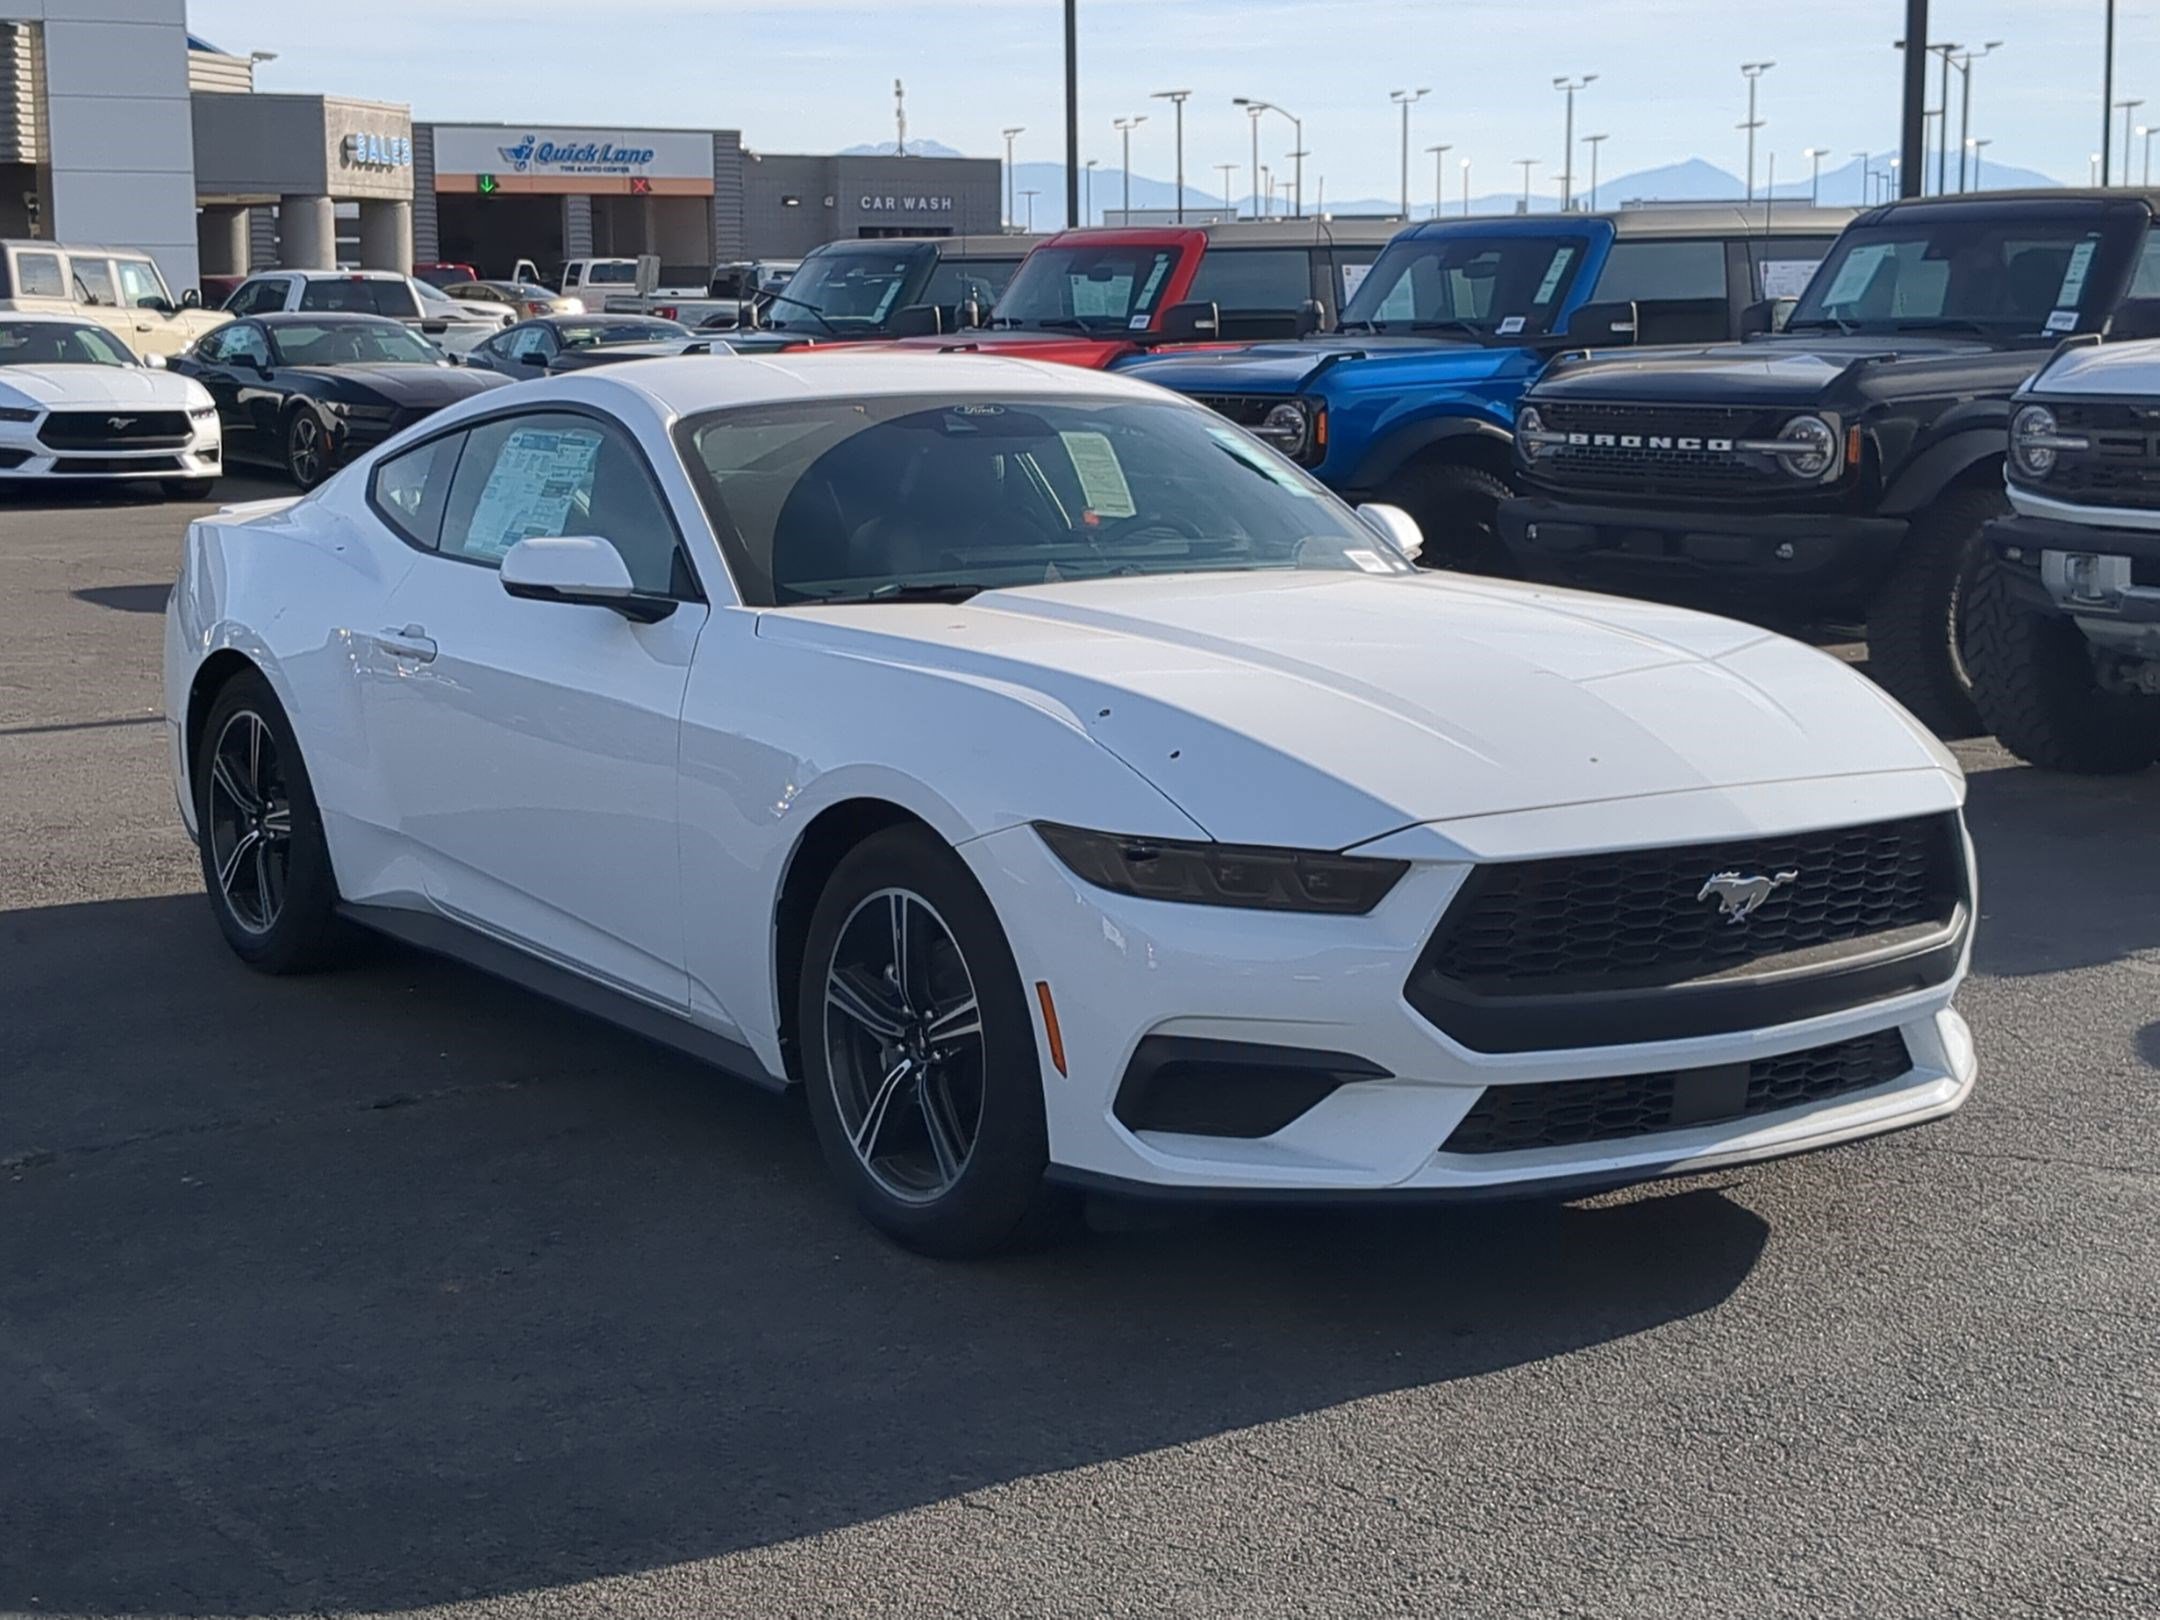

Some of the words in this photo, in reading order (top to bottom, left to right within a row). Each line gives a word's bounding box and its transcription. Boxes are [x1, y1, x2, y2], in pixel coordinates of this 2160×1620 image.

[356, 132, 411, 167] SALES
[537, 142, 598, 164] Quick
[598, 142, 654, 164] Lane
[861, 196, 896, 210] CAR
[903, 197, 951, 210] WASH
[1569, 433, 1732, 451] BRONCO
